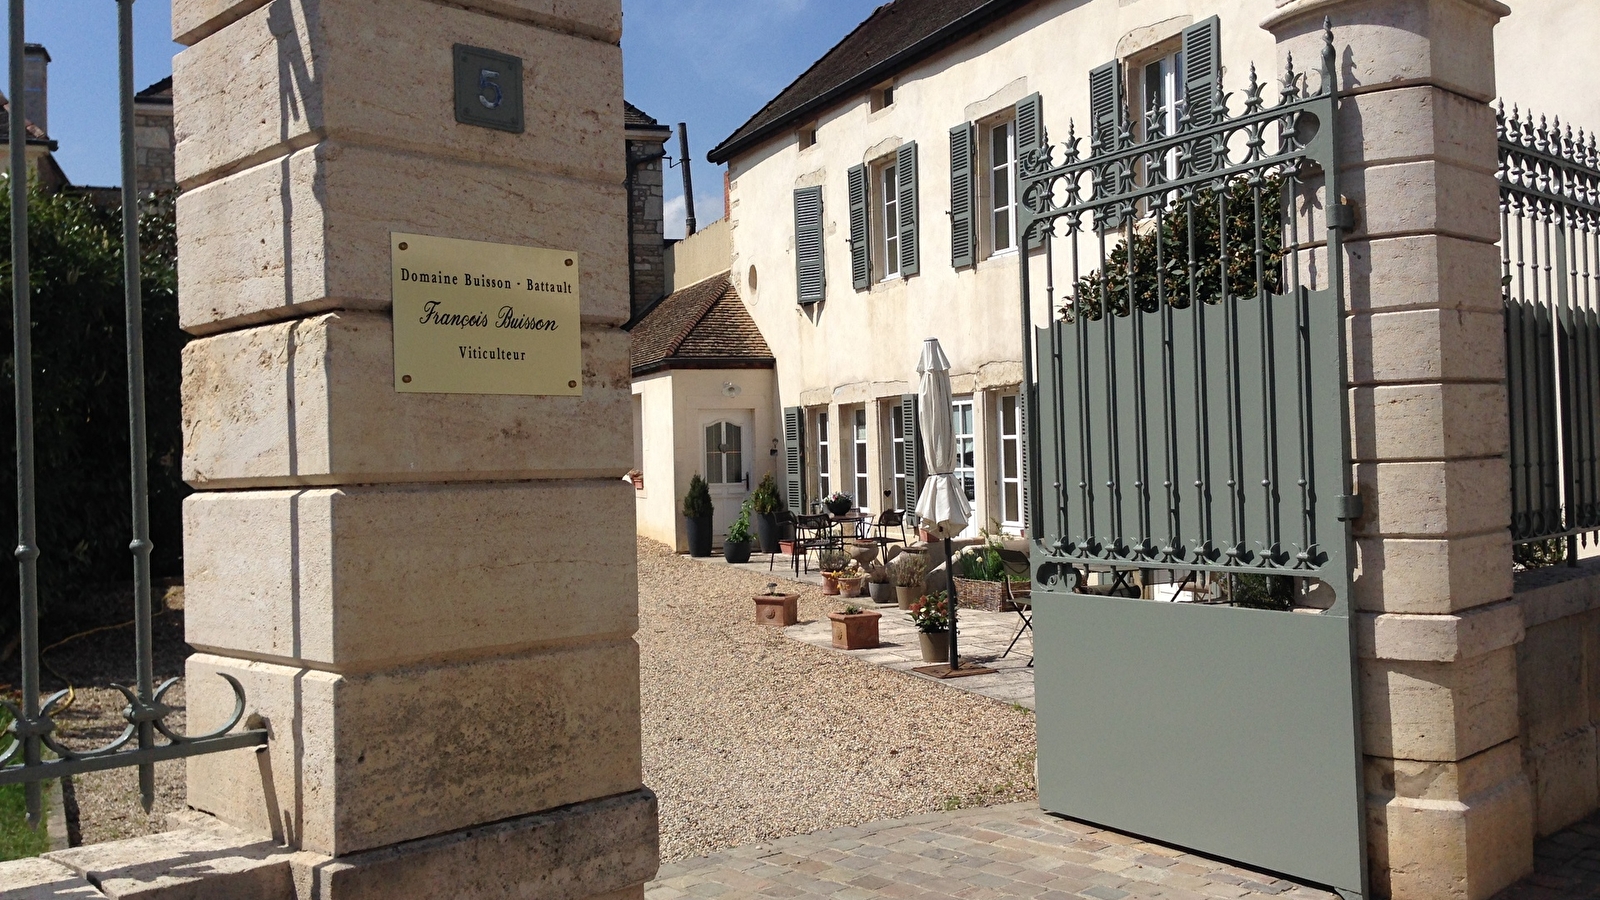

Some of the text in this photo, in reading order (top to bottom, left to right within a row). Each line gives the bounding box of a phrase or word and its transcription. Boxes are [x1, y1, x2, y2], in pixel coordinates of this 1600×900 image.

[479, 68, 502, 110] 5
[400, 267, 459, 286] Domaine
[464, 273, 512, 290] Buisson
[526, 278, 572, 294] Battault
[419, 300, 559, 331] François Buisson
[458, 345, 526, 361] Viticulteur
